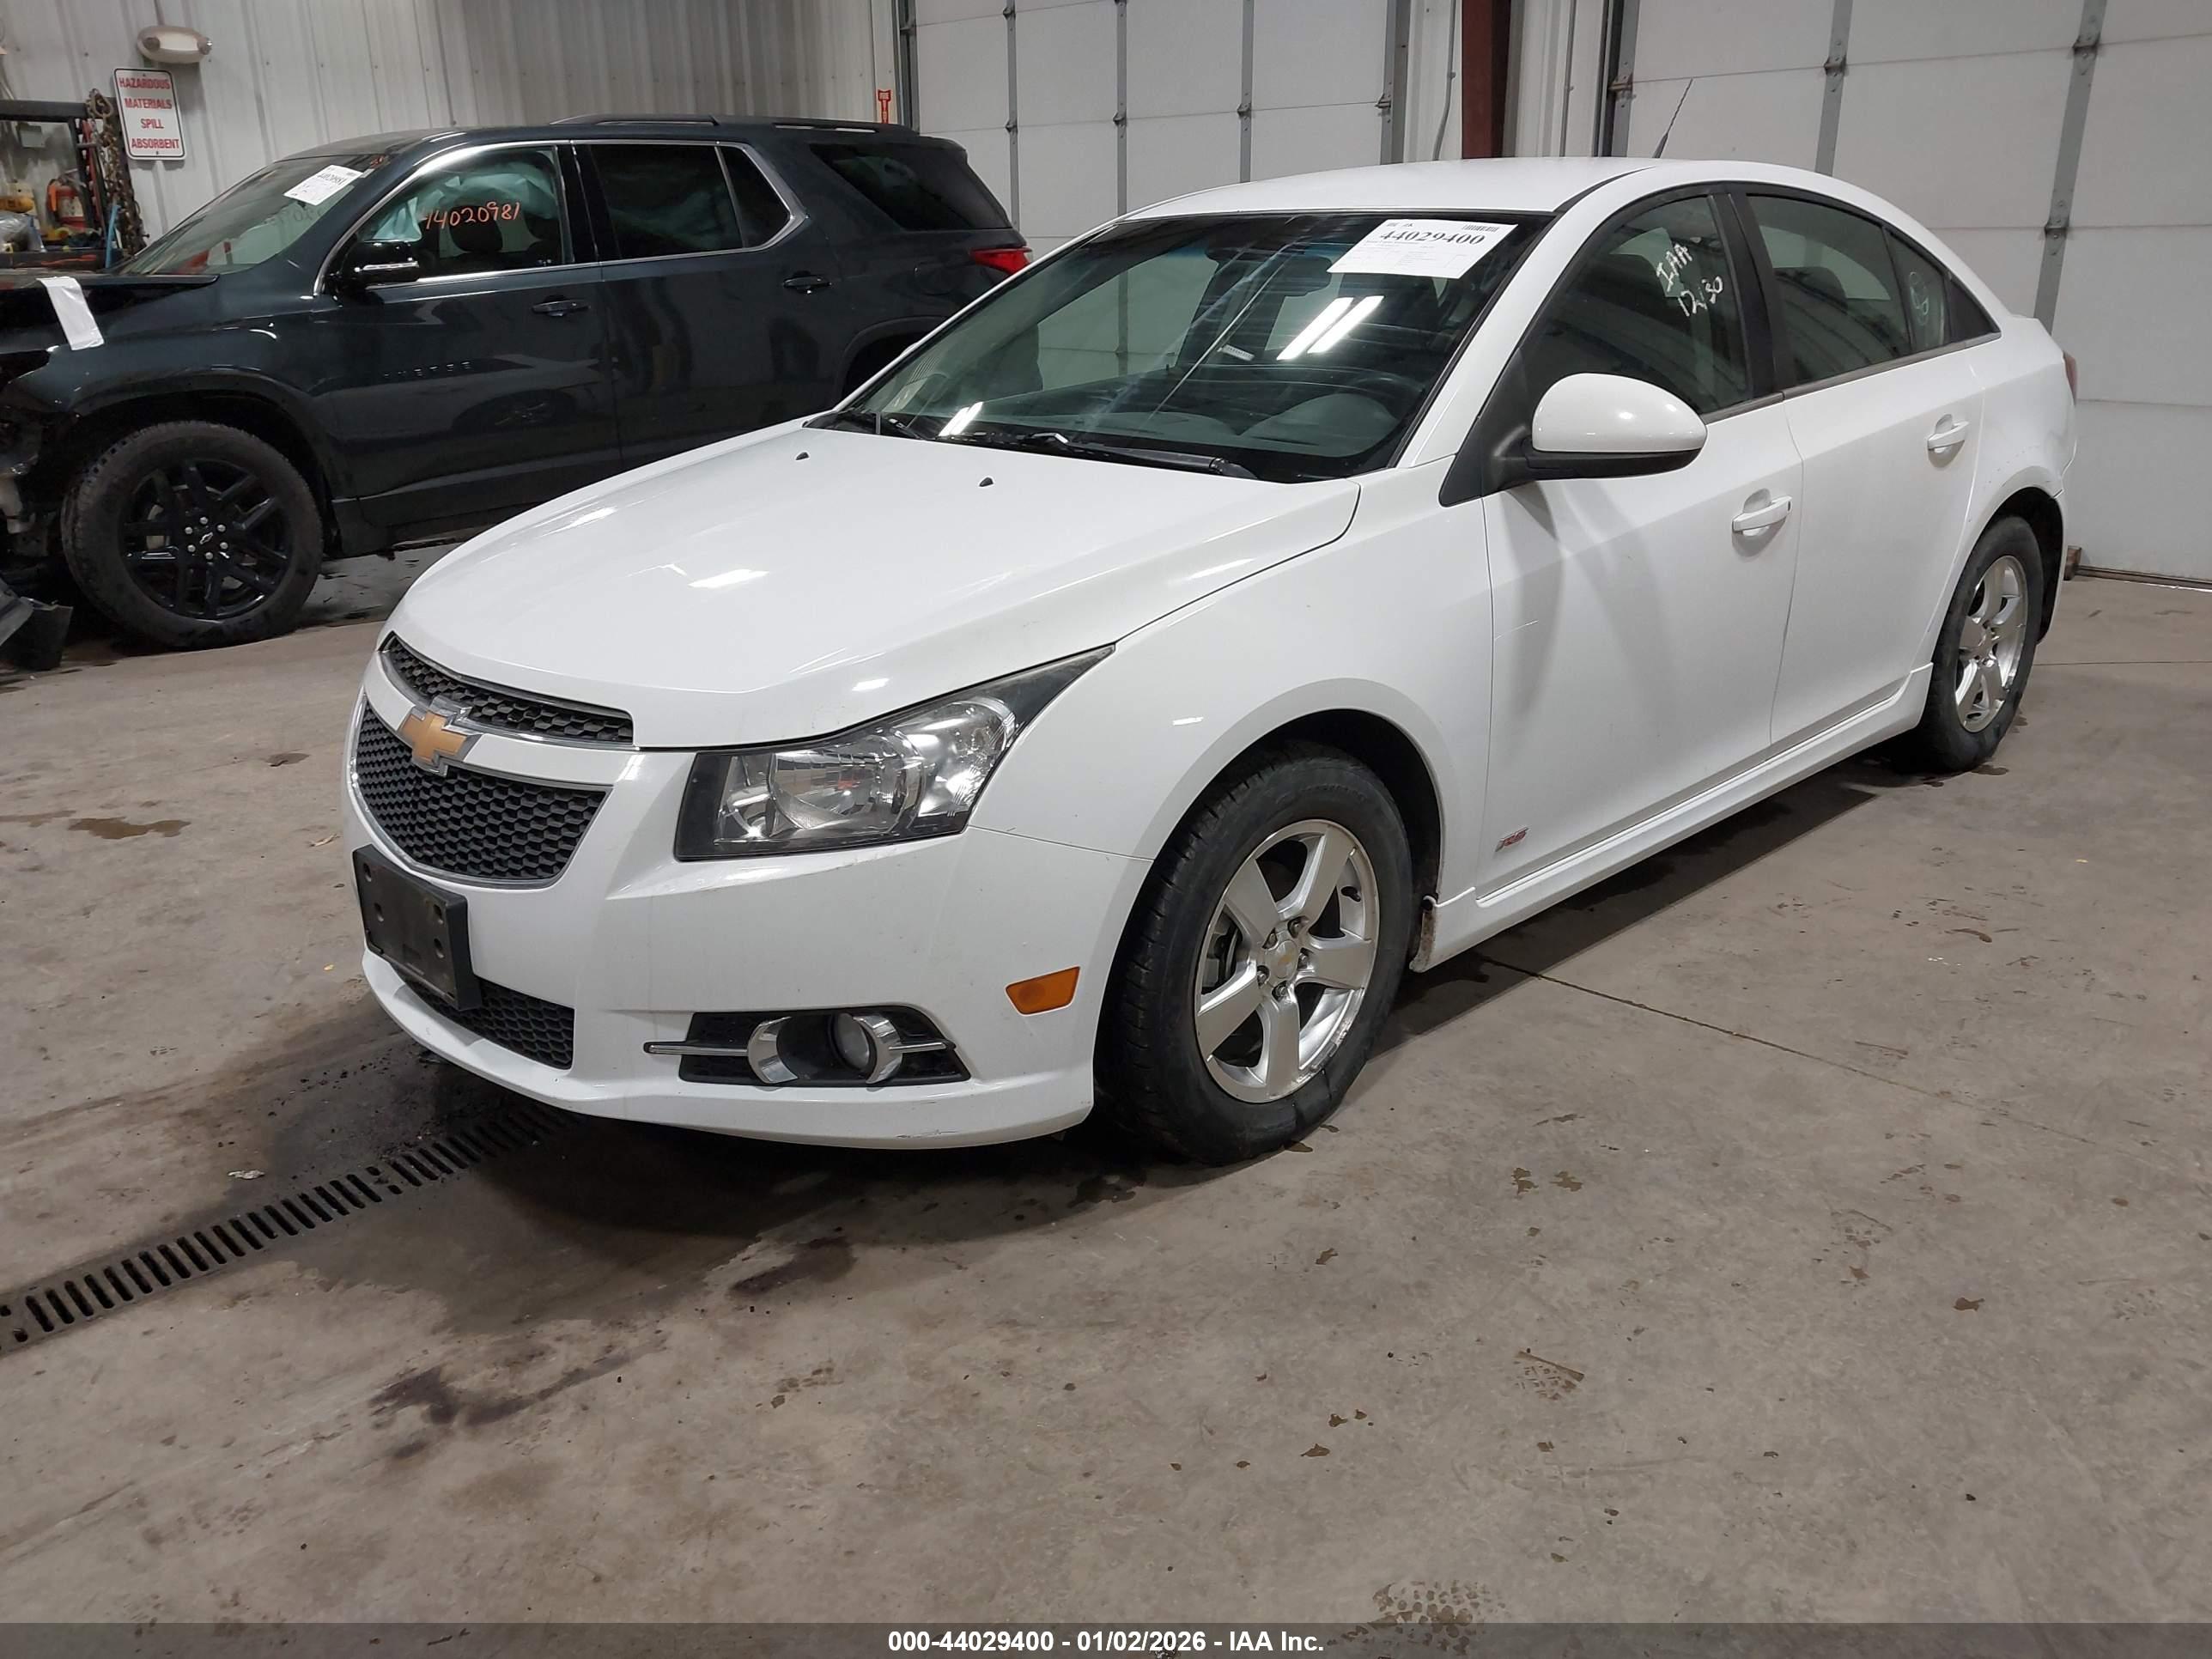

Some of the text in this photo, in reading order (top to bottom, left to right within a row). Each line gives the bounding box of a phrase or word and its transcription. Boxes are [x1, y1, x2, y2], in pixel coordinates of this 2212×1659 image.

[118, 77, 171, 89] HAZARDOUS
[125, 98, 173, 110] MATERIALS
[140, 118, 165, 129] SPILL
[131, 138, 179, 149] ABSORBENT
[1379, 229, 1486, 246] 44029400
